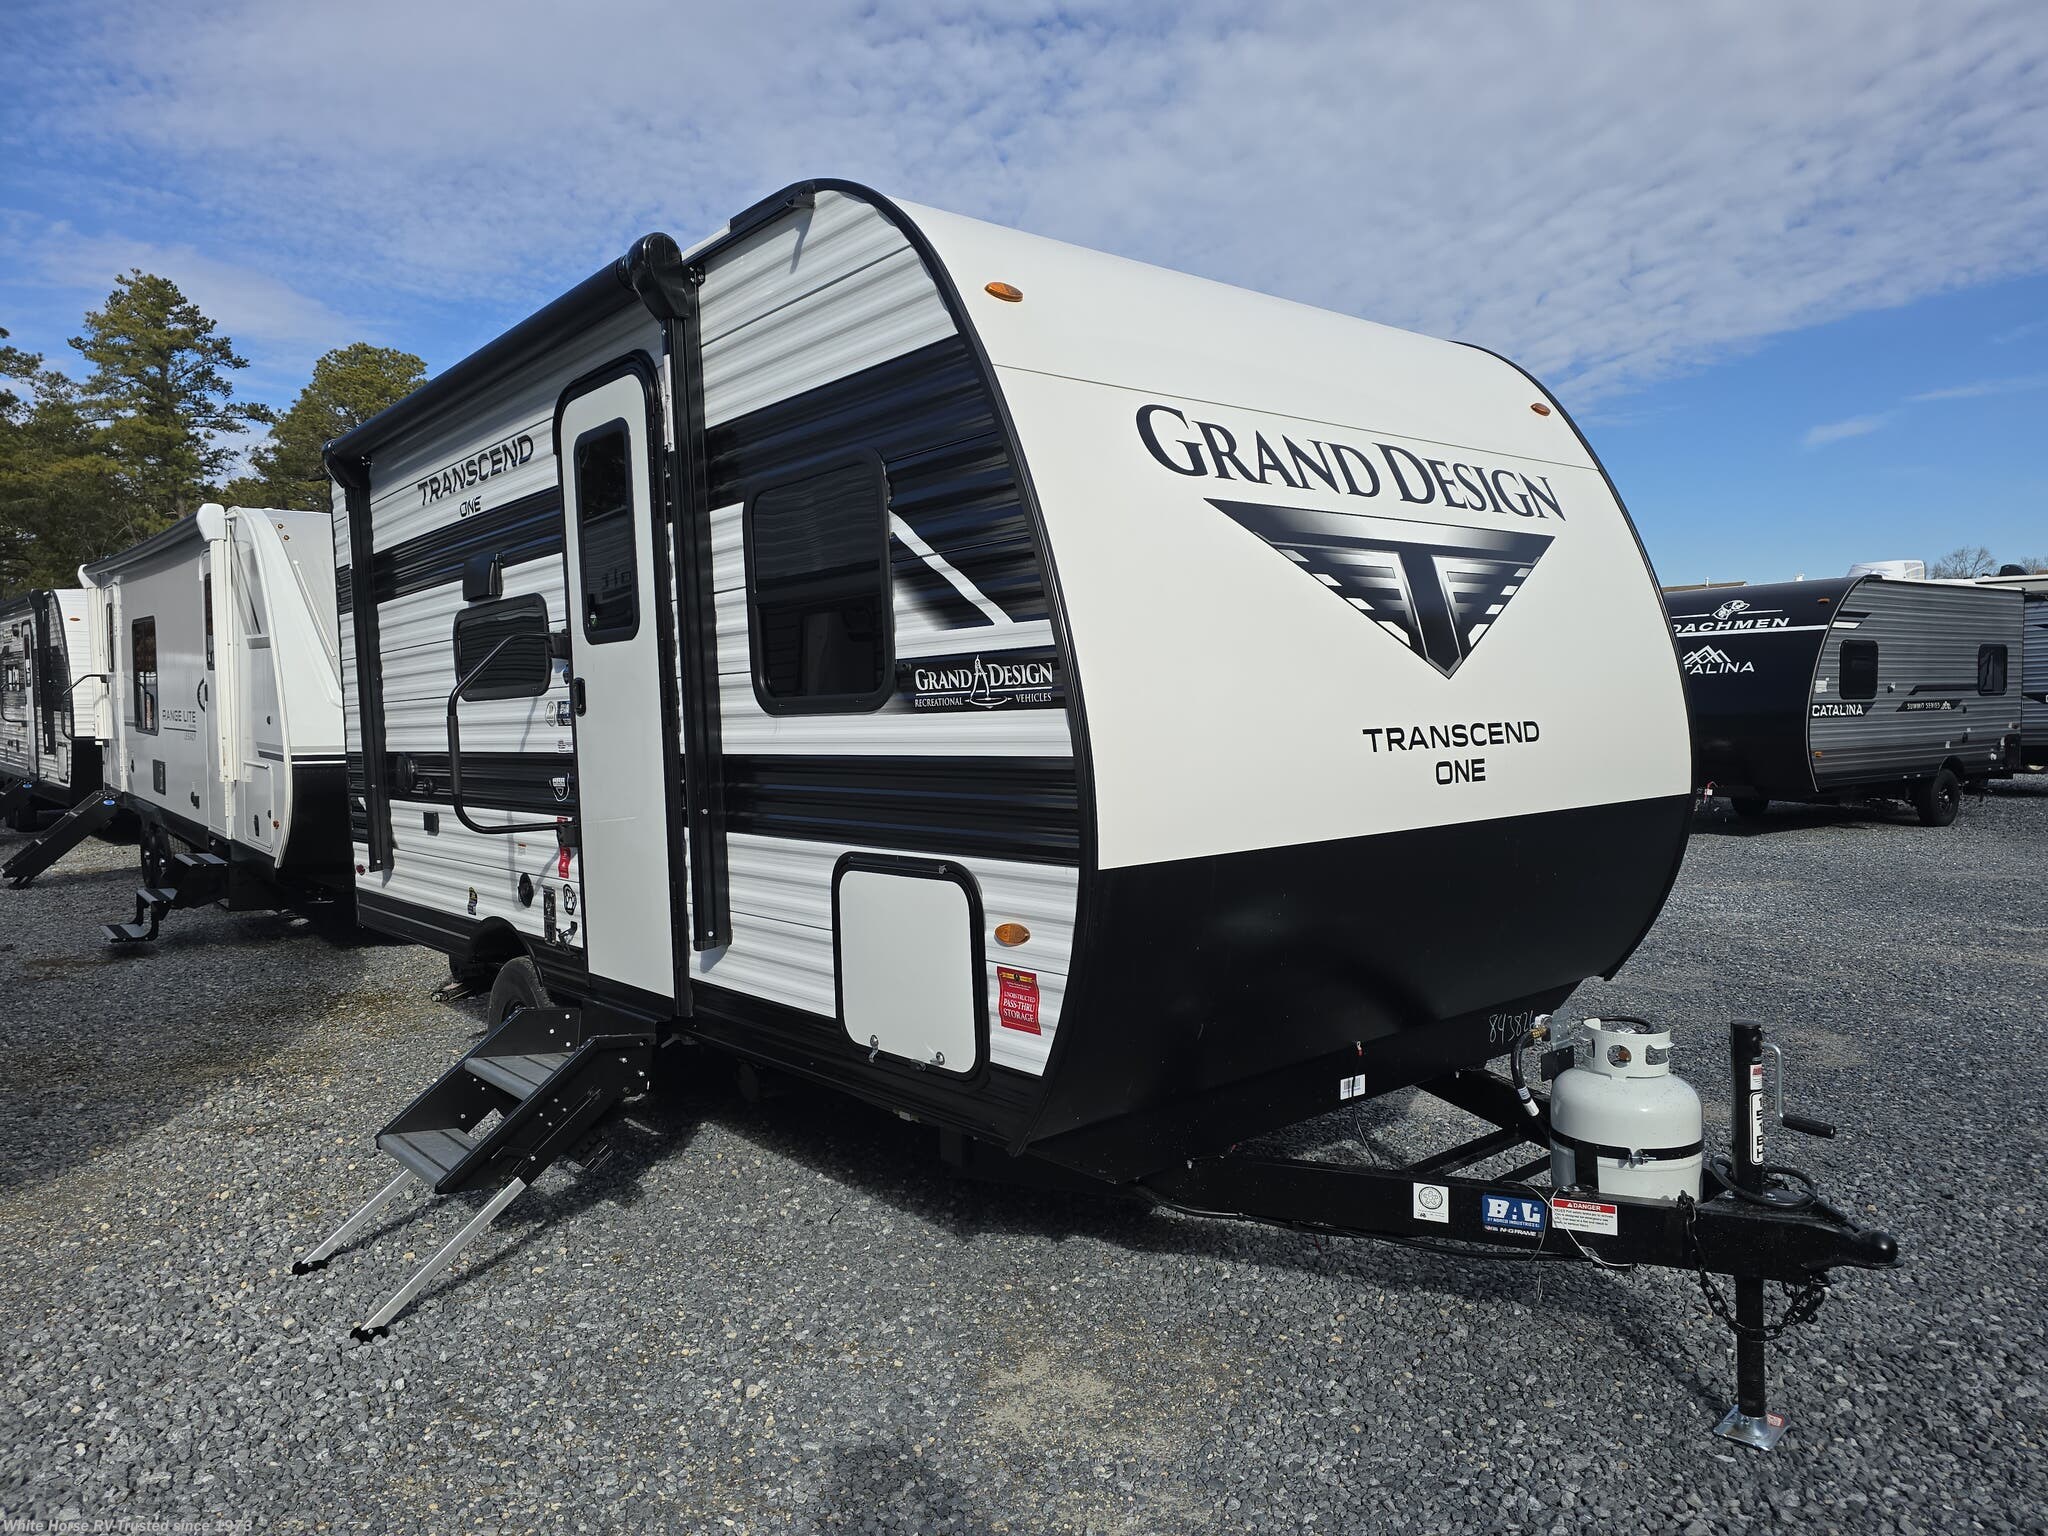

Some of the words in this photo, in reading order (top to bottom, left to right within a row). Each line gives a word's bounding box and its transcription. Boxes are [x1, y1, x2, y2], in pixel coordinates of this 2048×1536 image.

[417, 434, 534, 506] TRANSCEND
[1135, 403, 1382, 499] GRAND
[1372, 442, 1566, 521] DESIGN
[459, 495, 482, 517] ONE
[1673, 617, 1790, 633] OACHMEN
[914, 668, 972, 691] GRAND
[986, 662, 1053, 687] DESIGN
[914, 697, 964, 708] RECREATIONAL
[1015, 693, 1052, 703] VEHICLES
[1811, 704, 1864, 717] CATALINA
[1362, 720, 1541, 753] TRANSCEND
[1435, 758, 1486, 785] ONE
[1004, 999, 1035, 1012] PASS-THRU
[1004, 1009, 1035, 1022] STORAGE
[1487, 1198, 1541, 1223] BAL
[1573, 1203, 1601, 1211] DANGER
